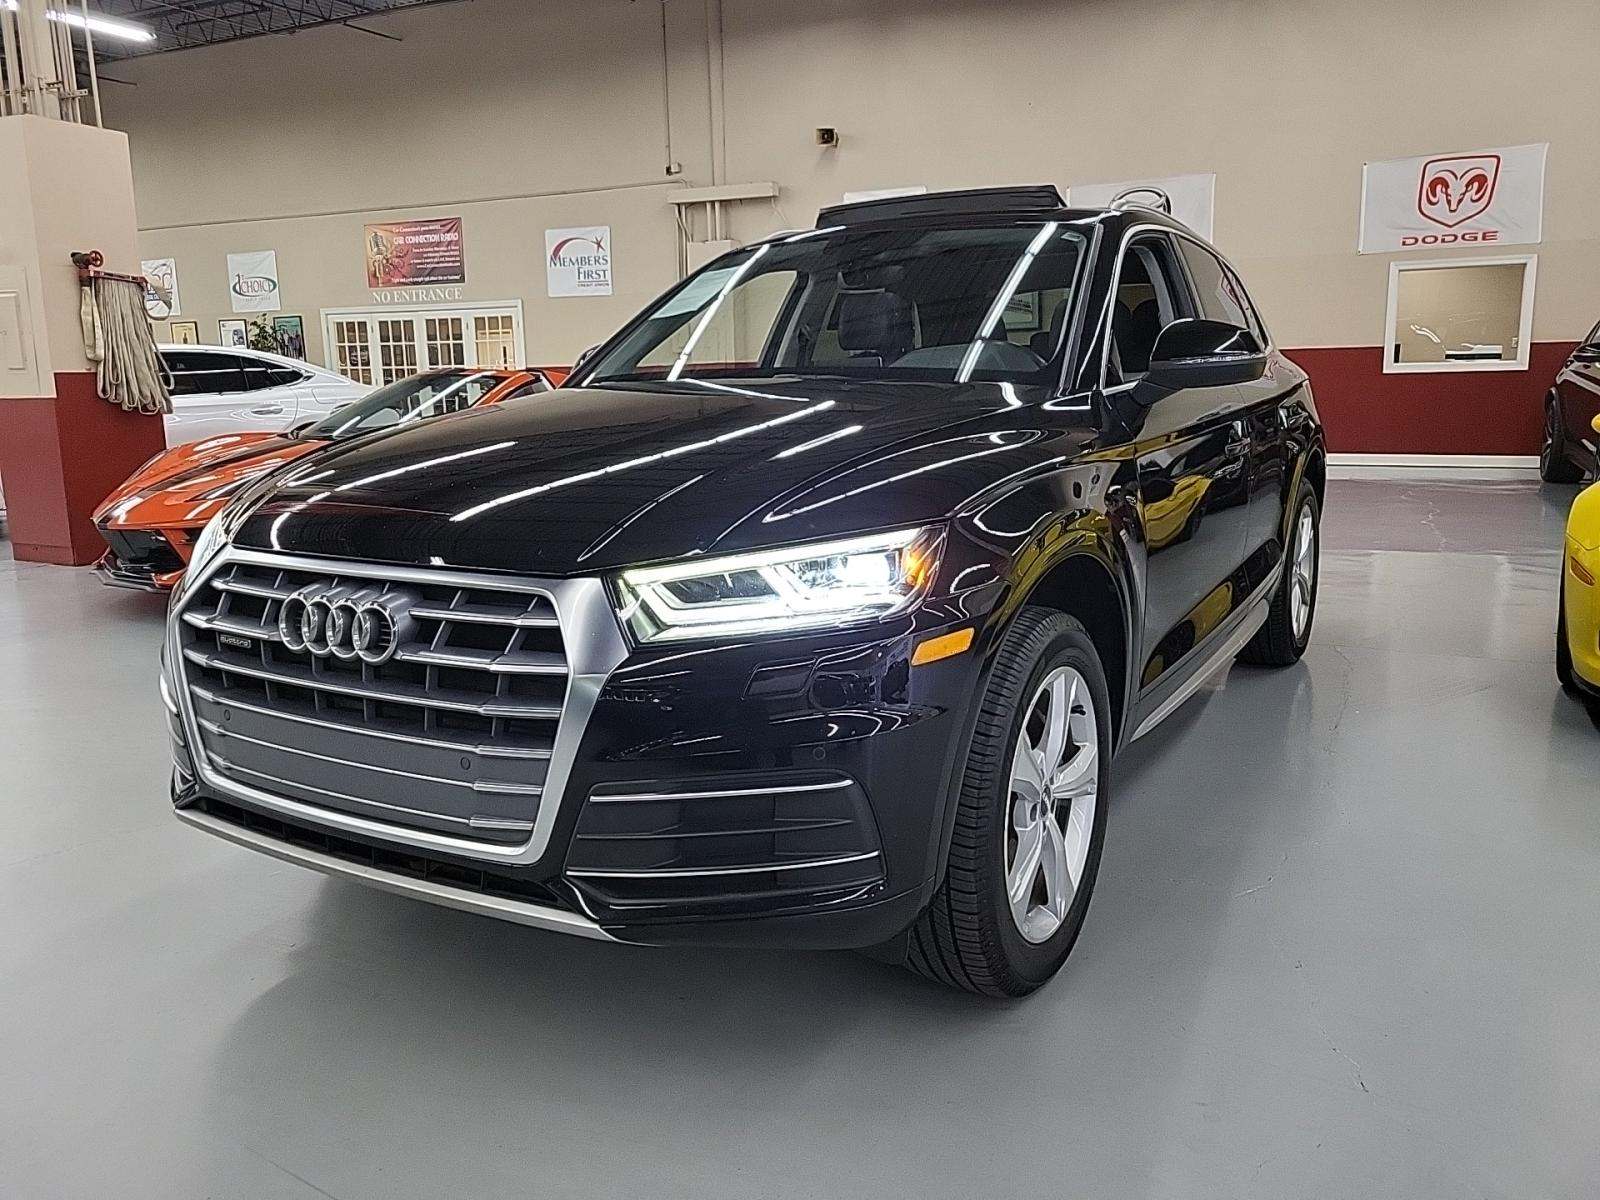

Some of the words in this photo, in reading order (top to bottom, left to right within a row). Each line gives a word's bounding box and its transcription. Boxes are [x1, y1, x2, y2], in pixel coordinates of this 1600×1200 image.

[1402, 231, 1498, 246] DODGE
[550, 254, 608, 268] MEMBERS
[577, 266, 608, 280] FIRST
[372, 290, 391, 303] NO
[394, 287, 463, 303] ENTRANCE
